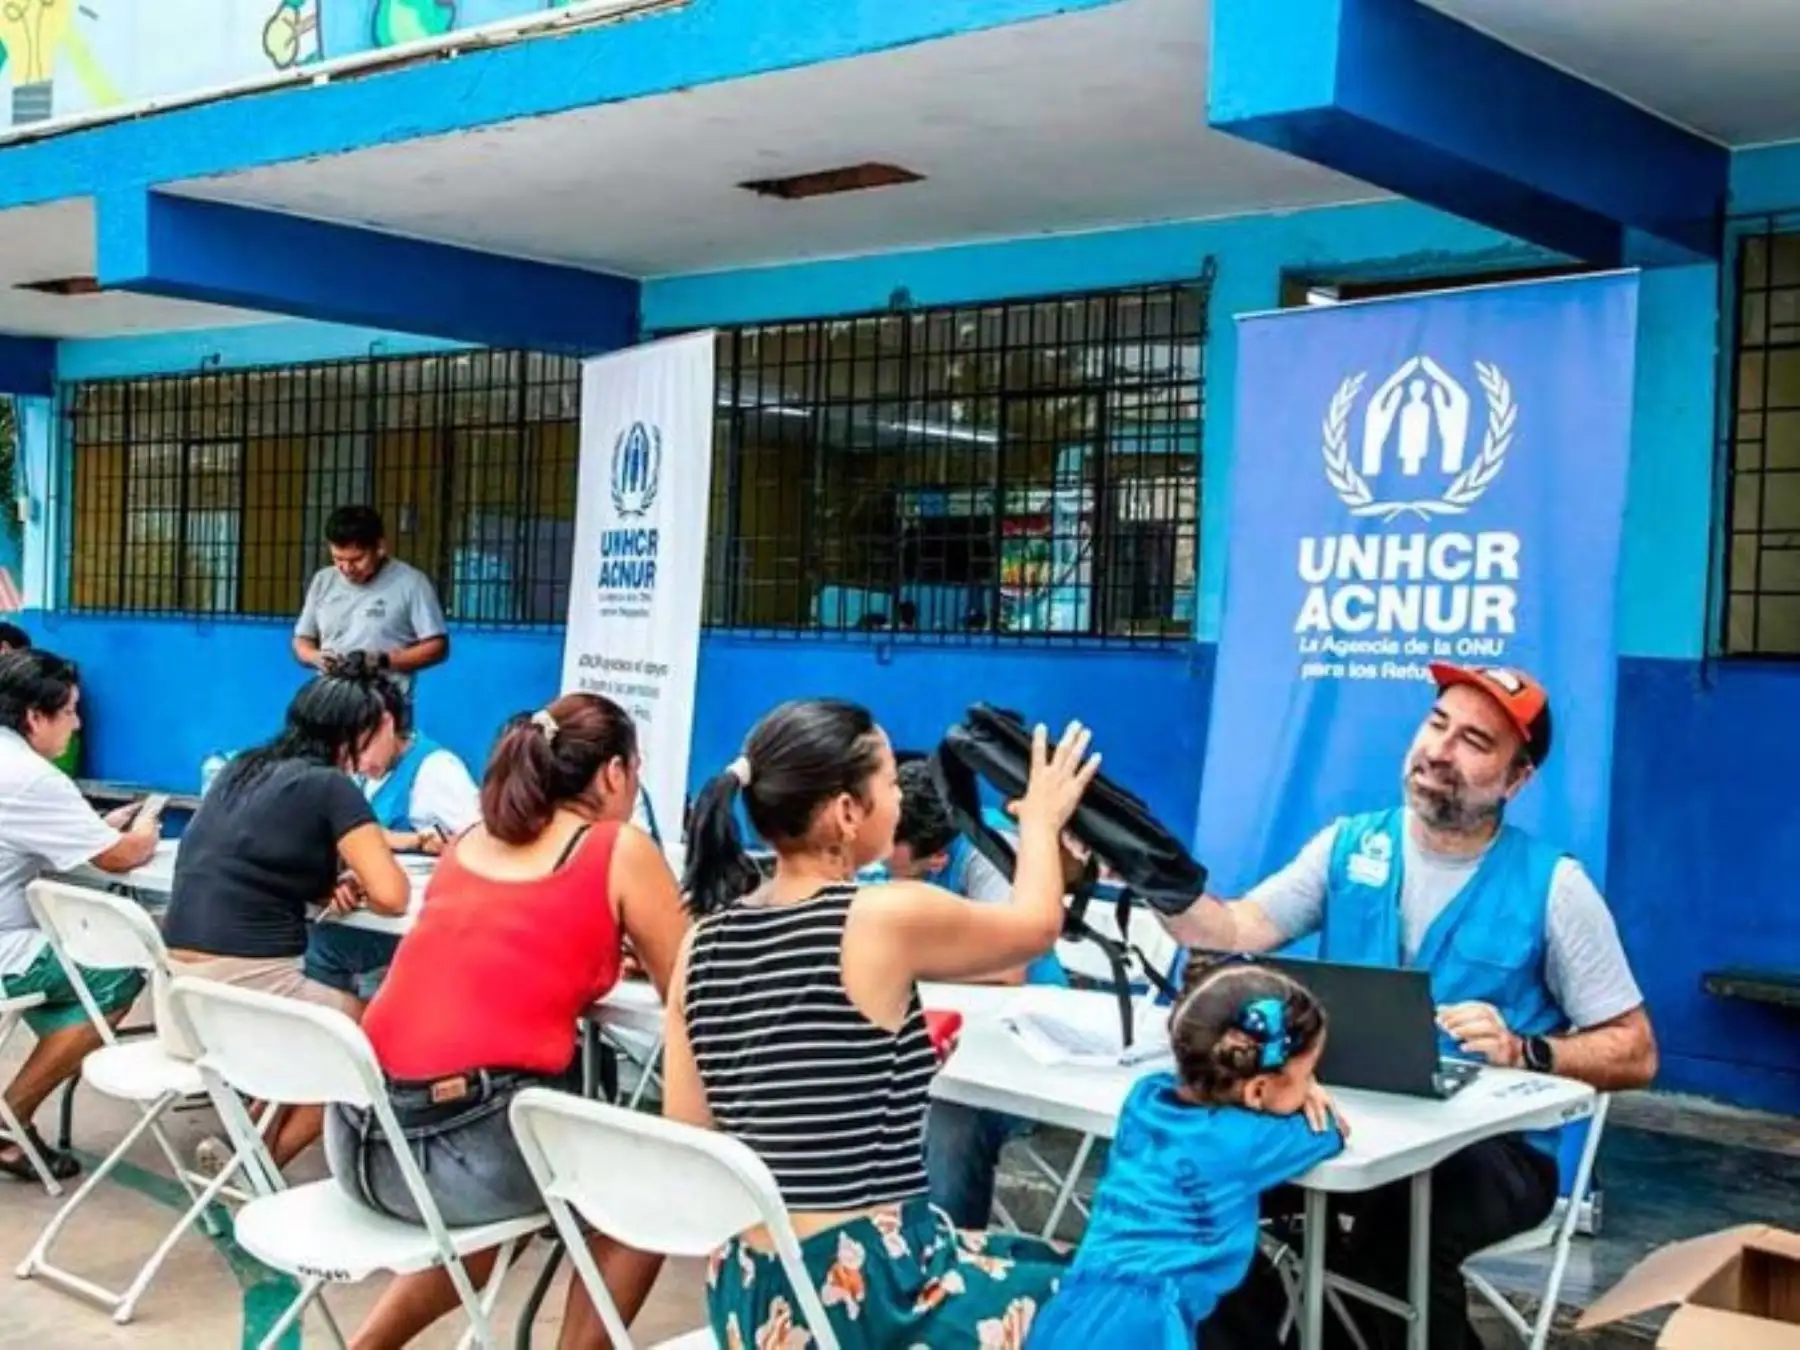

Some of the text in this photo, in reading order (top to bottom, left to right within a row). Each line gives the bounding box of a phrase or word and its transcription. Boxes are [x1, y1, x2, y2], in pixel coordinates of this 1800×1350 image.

[601, 528, 658, 557] UNHCR
[1299, 531, 1521, 583] UNHCR
[598, 560, 656, 588] ACNUR
[1295, 584, 1516, 634] ACNUR
[1300, 635, 1505, 657] La Agencia de la ONU
[1301, 662, 1345, 681] para
[1349, 661, 1376, 679] los
